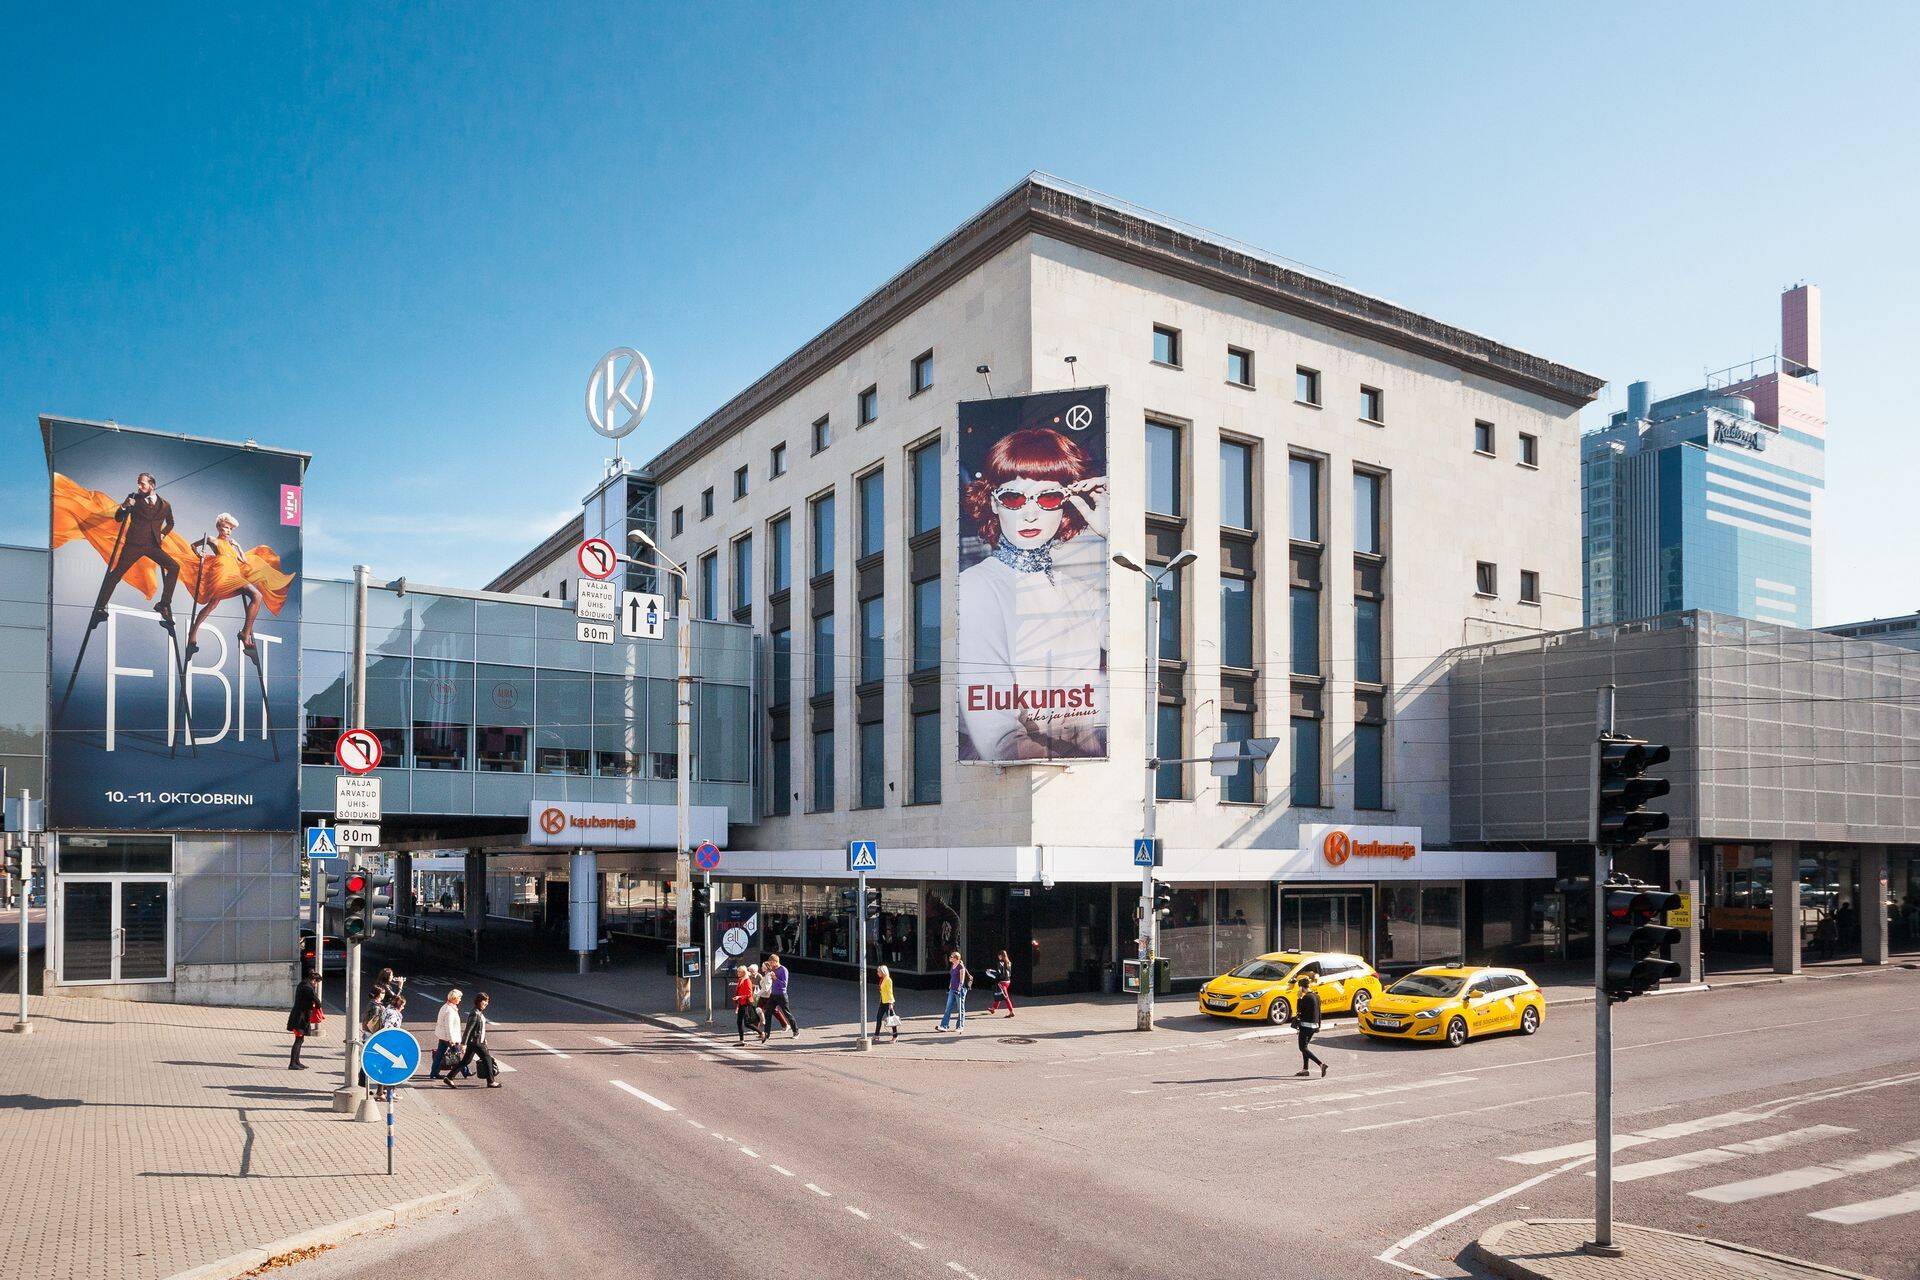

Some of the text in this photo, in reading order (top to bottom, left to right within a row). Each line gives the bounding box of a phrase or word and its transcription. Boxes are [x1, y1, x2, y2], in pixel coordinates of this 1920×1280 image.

[581, 591, 613, 600] ARVATUD
[968, 684, 1094, 711] Elukunst
[1026, 708, 1100, 724] üks ja ainus
[159, 792, 254, 805] OKTOOBRINI
[340, 790, 377, 798] ARVATUD
[570, 815, 636, 831] kaubamaja
[343, 829, 372, 842] 80m
[1352, 840, 1415, 860] kaubamaja
